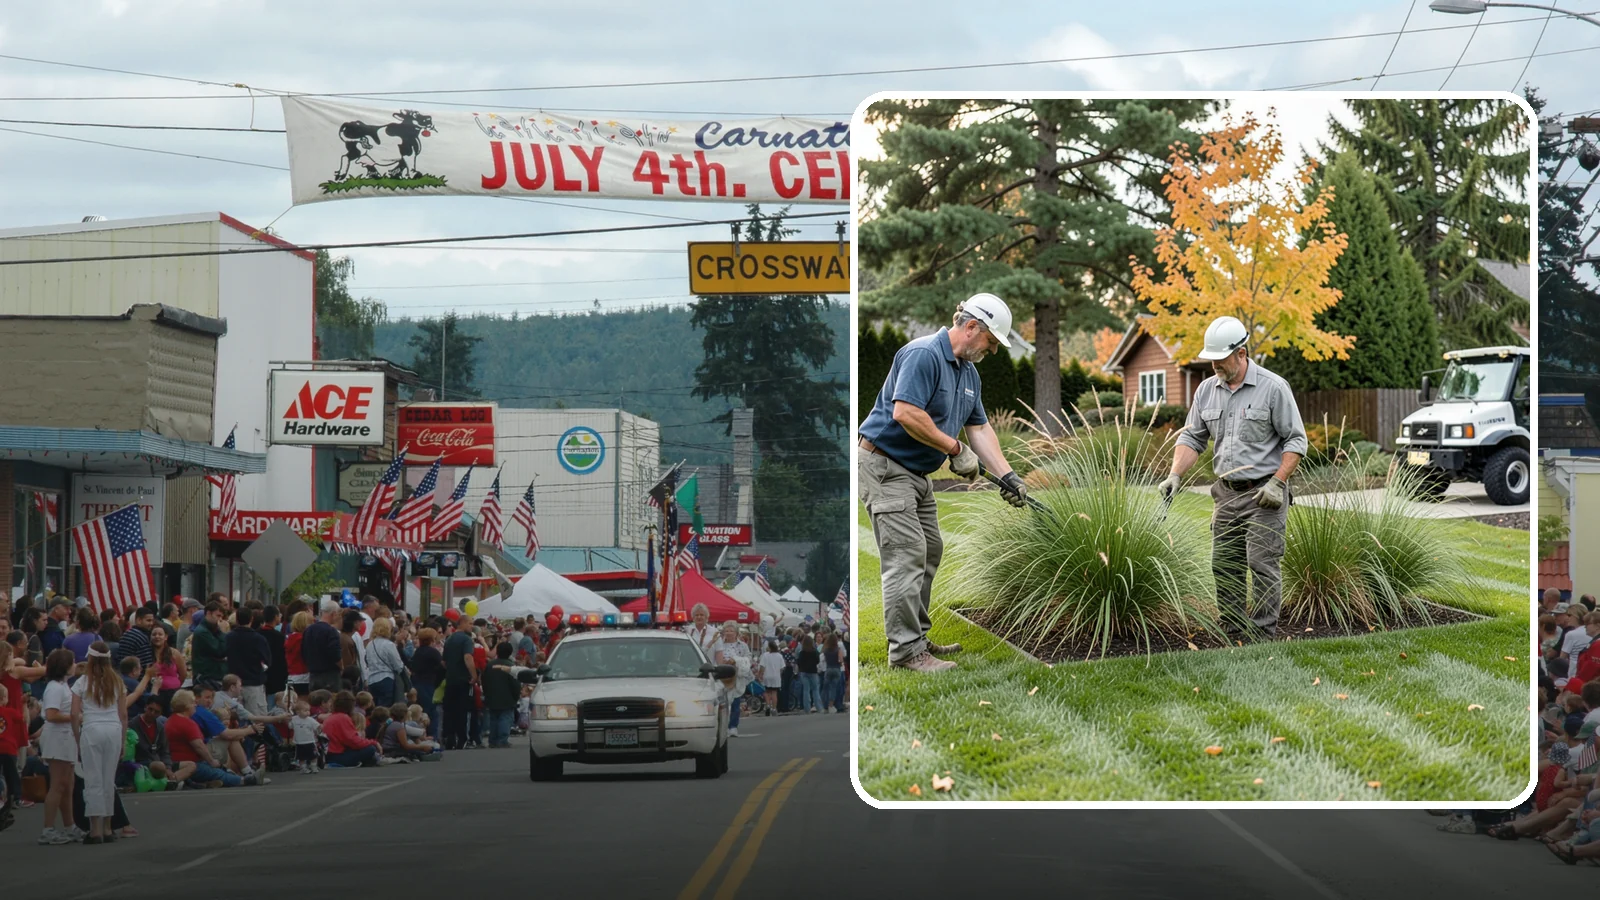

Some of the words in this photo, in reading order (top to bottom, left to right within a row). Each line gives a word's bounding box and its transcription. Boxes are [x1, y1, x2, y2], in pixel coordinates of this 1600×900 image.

[695, 121, 850, 149] Carnat
[481, 141, 604, 191] JULY
[632, 150, 746, 197] 4th.
[697, 254, 850, 280] CROSSWA
[283, 380, 373, 420] ACE
[406, 409, 452, 421] CEDAR
[284, 421, 371, 436] Hardware
[416, 428, 477, 447] Coca-Cola
[83, 484, 94, 494] St.
[96, 485, 124, 495] Vincent
[126, 485, 135, 495] de
[138, 486, 155, 495] Paul
[688, 526, 742, 535] CRNATION
[699, 535, 731, 543] GLASS
